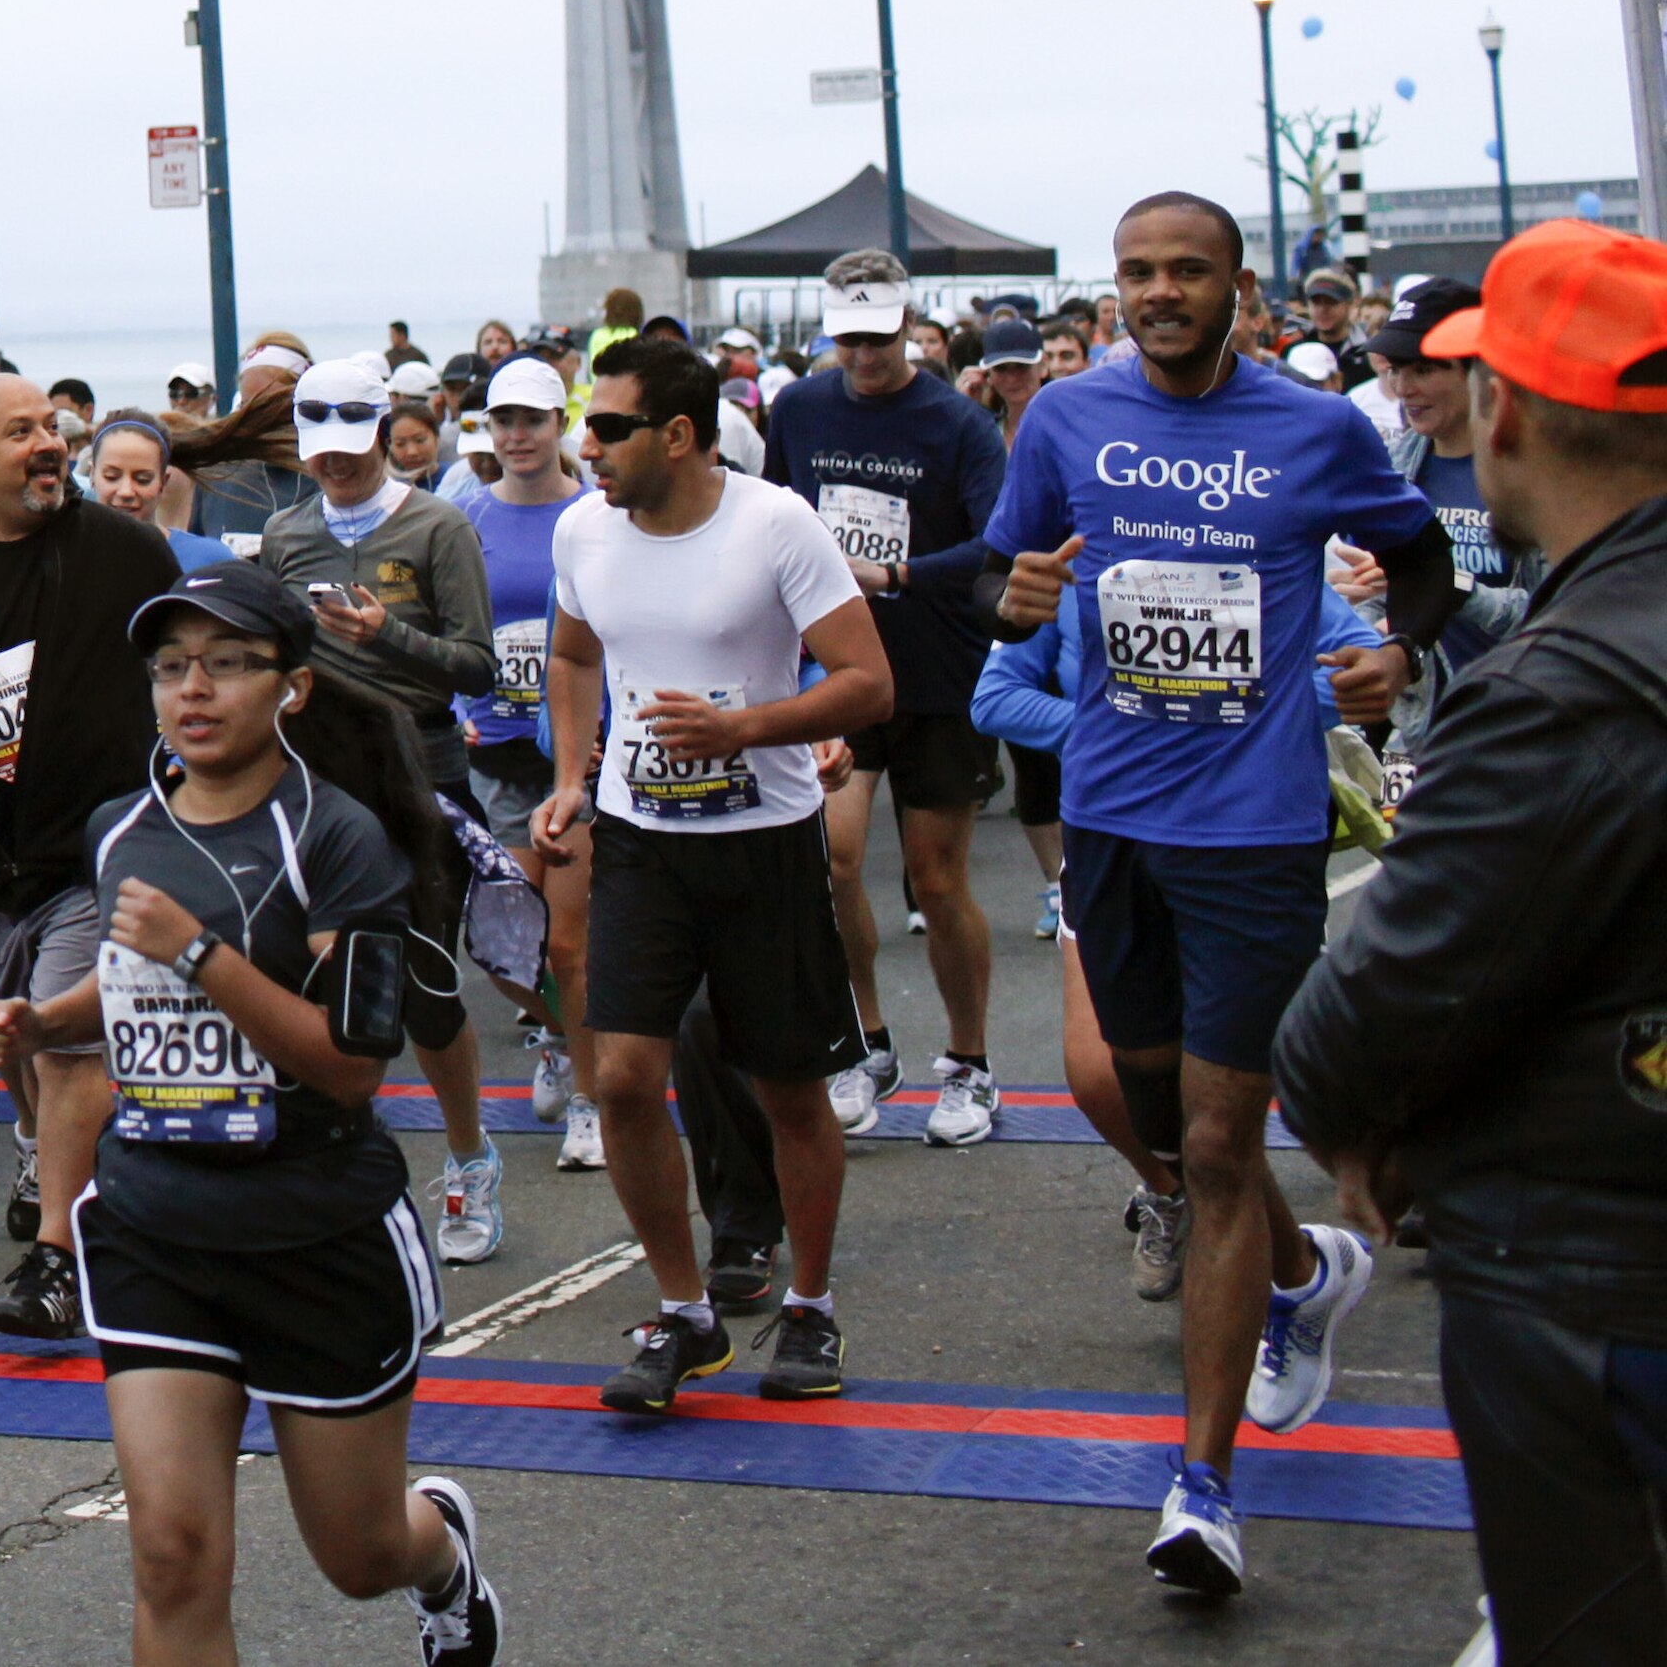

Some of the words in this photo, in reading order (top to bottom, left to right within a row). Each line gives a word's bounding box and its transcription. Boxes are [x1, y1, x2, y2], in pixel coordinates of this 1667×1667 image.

[163, 163, 186, 174] ANY
[163, 178, 187, 190] TIME
[866, 462, 924, 478] COLLEGE
[1095, 440, 1273, 512] Google
[847, 515, 872, 527] DAD
[1112, 515, 1196, 548] Running
[1198, 524, 1256, 550] Team
[1151, 571, 1180, 582] LAN
[1116, 593, 1155, 604] WIPRO
[1156, 597, 1173, 605] SAN
[1174, 597, 1219, 606] FRANCISCO
[1219, 598, 1256, 607] MARATHON
[1140, 605, 1213, 623] WMKJR
[507, 644, 545, 654] STUDE
[1108, 621, 1254, 673] 82944
[1131, 673, 1156, 687] HALF
[1158, 677, 1229, 692] MARATHON
[644, 784, 668, 795] HALF
[670, 779, 730, 793] MARATHON
[112, 1020, 266, 1078] 82690
[155, 1086, 236, 1102] MARATHON
